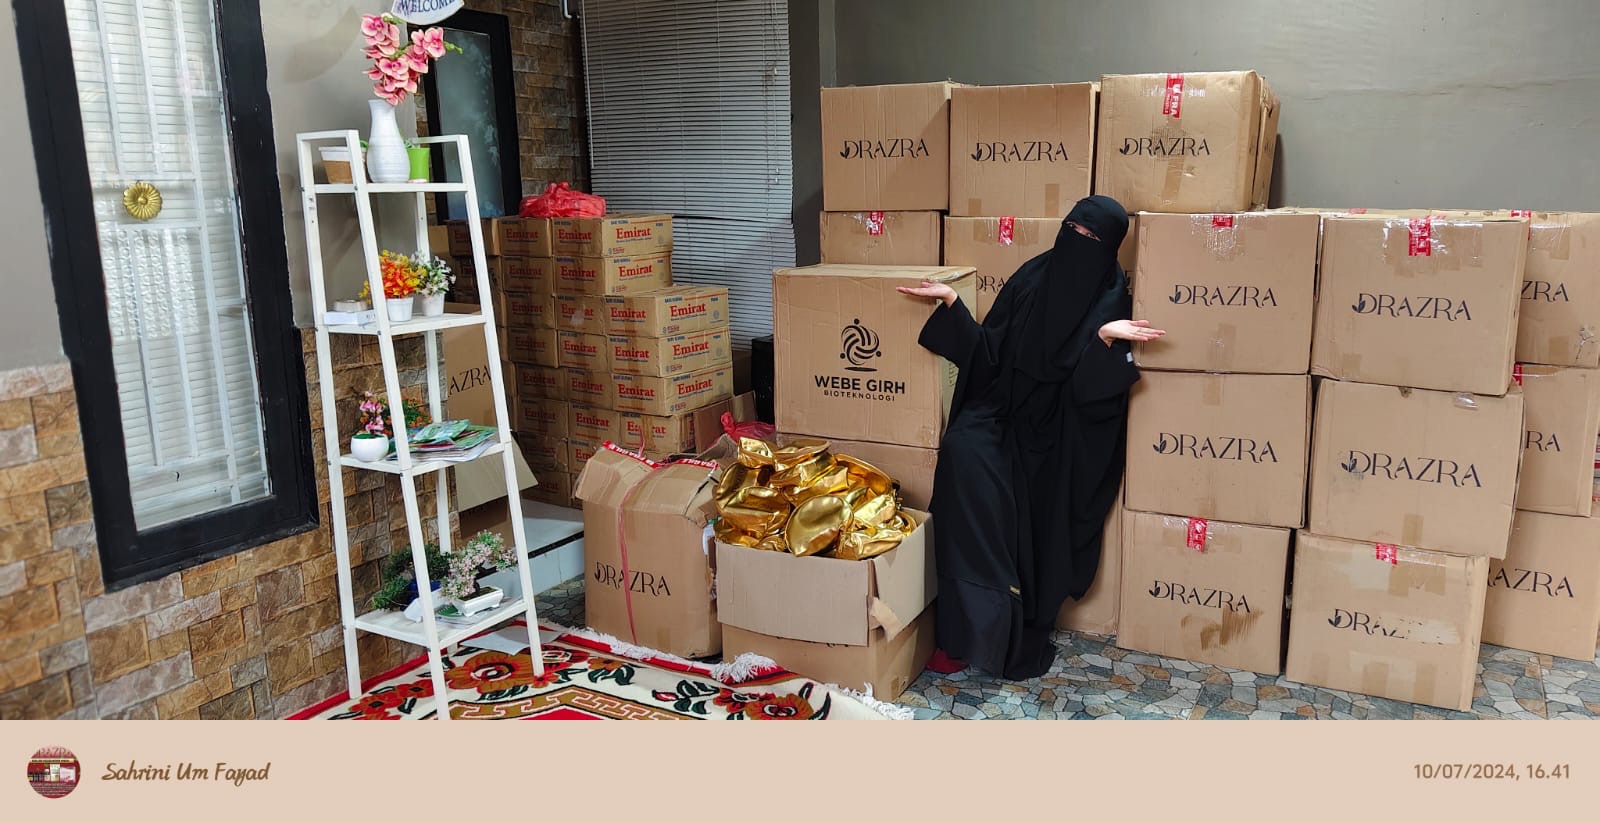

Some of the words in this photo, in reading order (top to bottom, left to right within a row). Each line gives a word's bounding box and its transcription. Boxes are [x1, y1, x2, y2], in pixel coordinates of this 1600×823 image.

[398, 0, 454, 15] WELCOM
[840, 139, 929, 159] DRAZRA
[971, 142, 1068, 162] DRAZRA
[1120, 138, 1209, 156] DRAZRA
[558, 229, 592, 241] Emirat
[616, 227, 652, 240] Emirat
[561, 266, 595, 278] Emirat
[619, 264, 653, 277] Emirat
[1169, 285, 1277, 307] DRAZRA
[611, 307, 646, 319] Emirat
[670, 303, 706, 317] Emirat
[1352, 293, 1471, 321] DRAZRA
[564, 340, 597, 353] Emirat
[615, 346, 650, 359] Emirat
[673, 340, 709, 356] Emirat
[618, 383, 655, 397] Emirat
[677, 378, 713, 395] Emirat
[814, 375, 861, 391] WEBE
[866, 379, 905, 394] GIRH
[824, 390, 895, 402] BIOTEKNOLOGI
[576, 414, 610, 428] Emirat
[1153, 433, 1277, 463] DRAZRA
[1341, 451, 1481, 487] DRAZRA
[1149, 581, 1250, 613] DRAZRA
